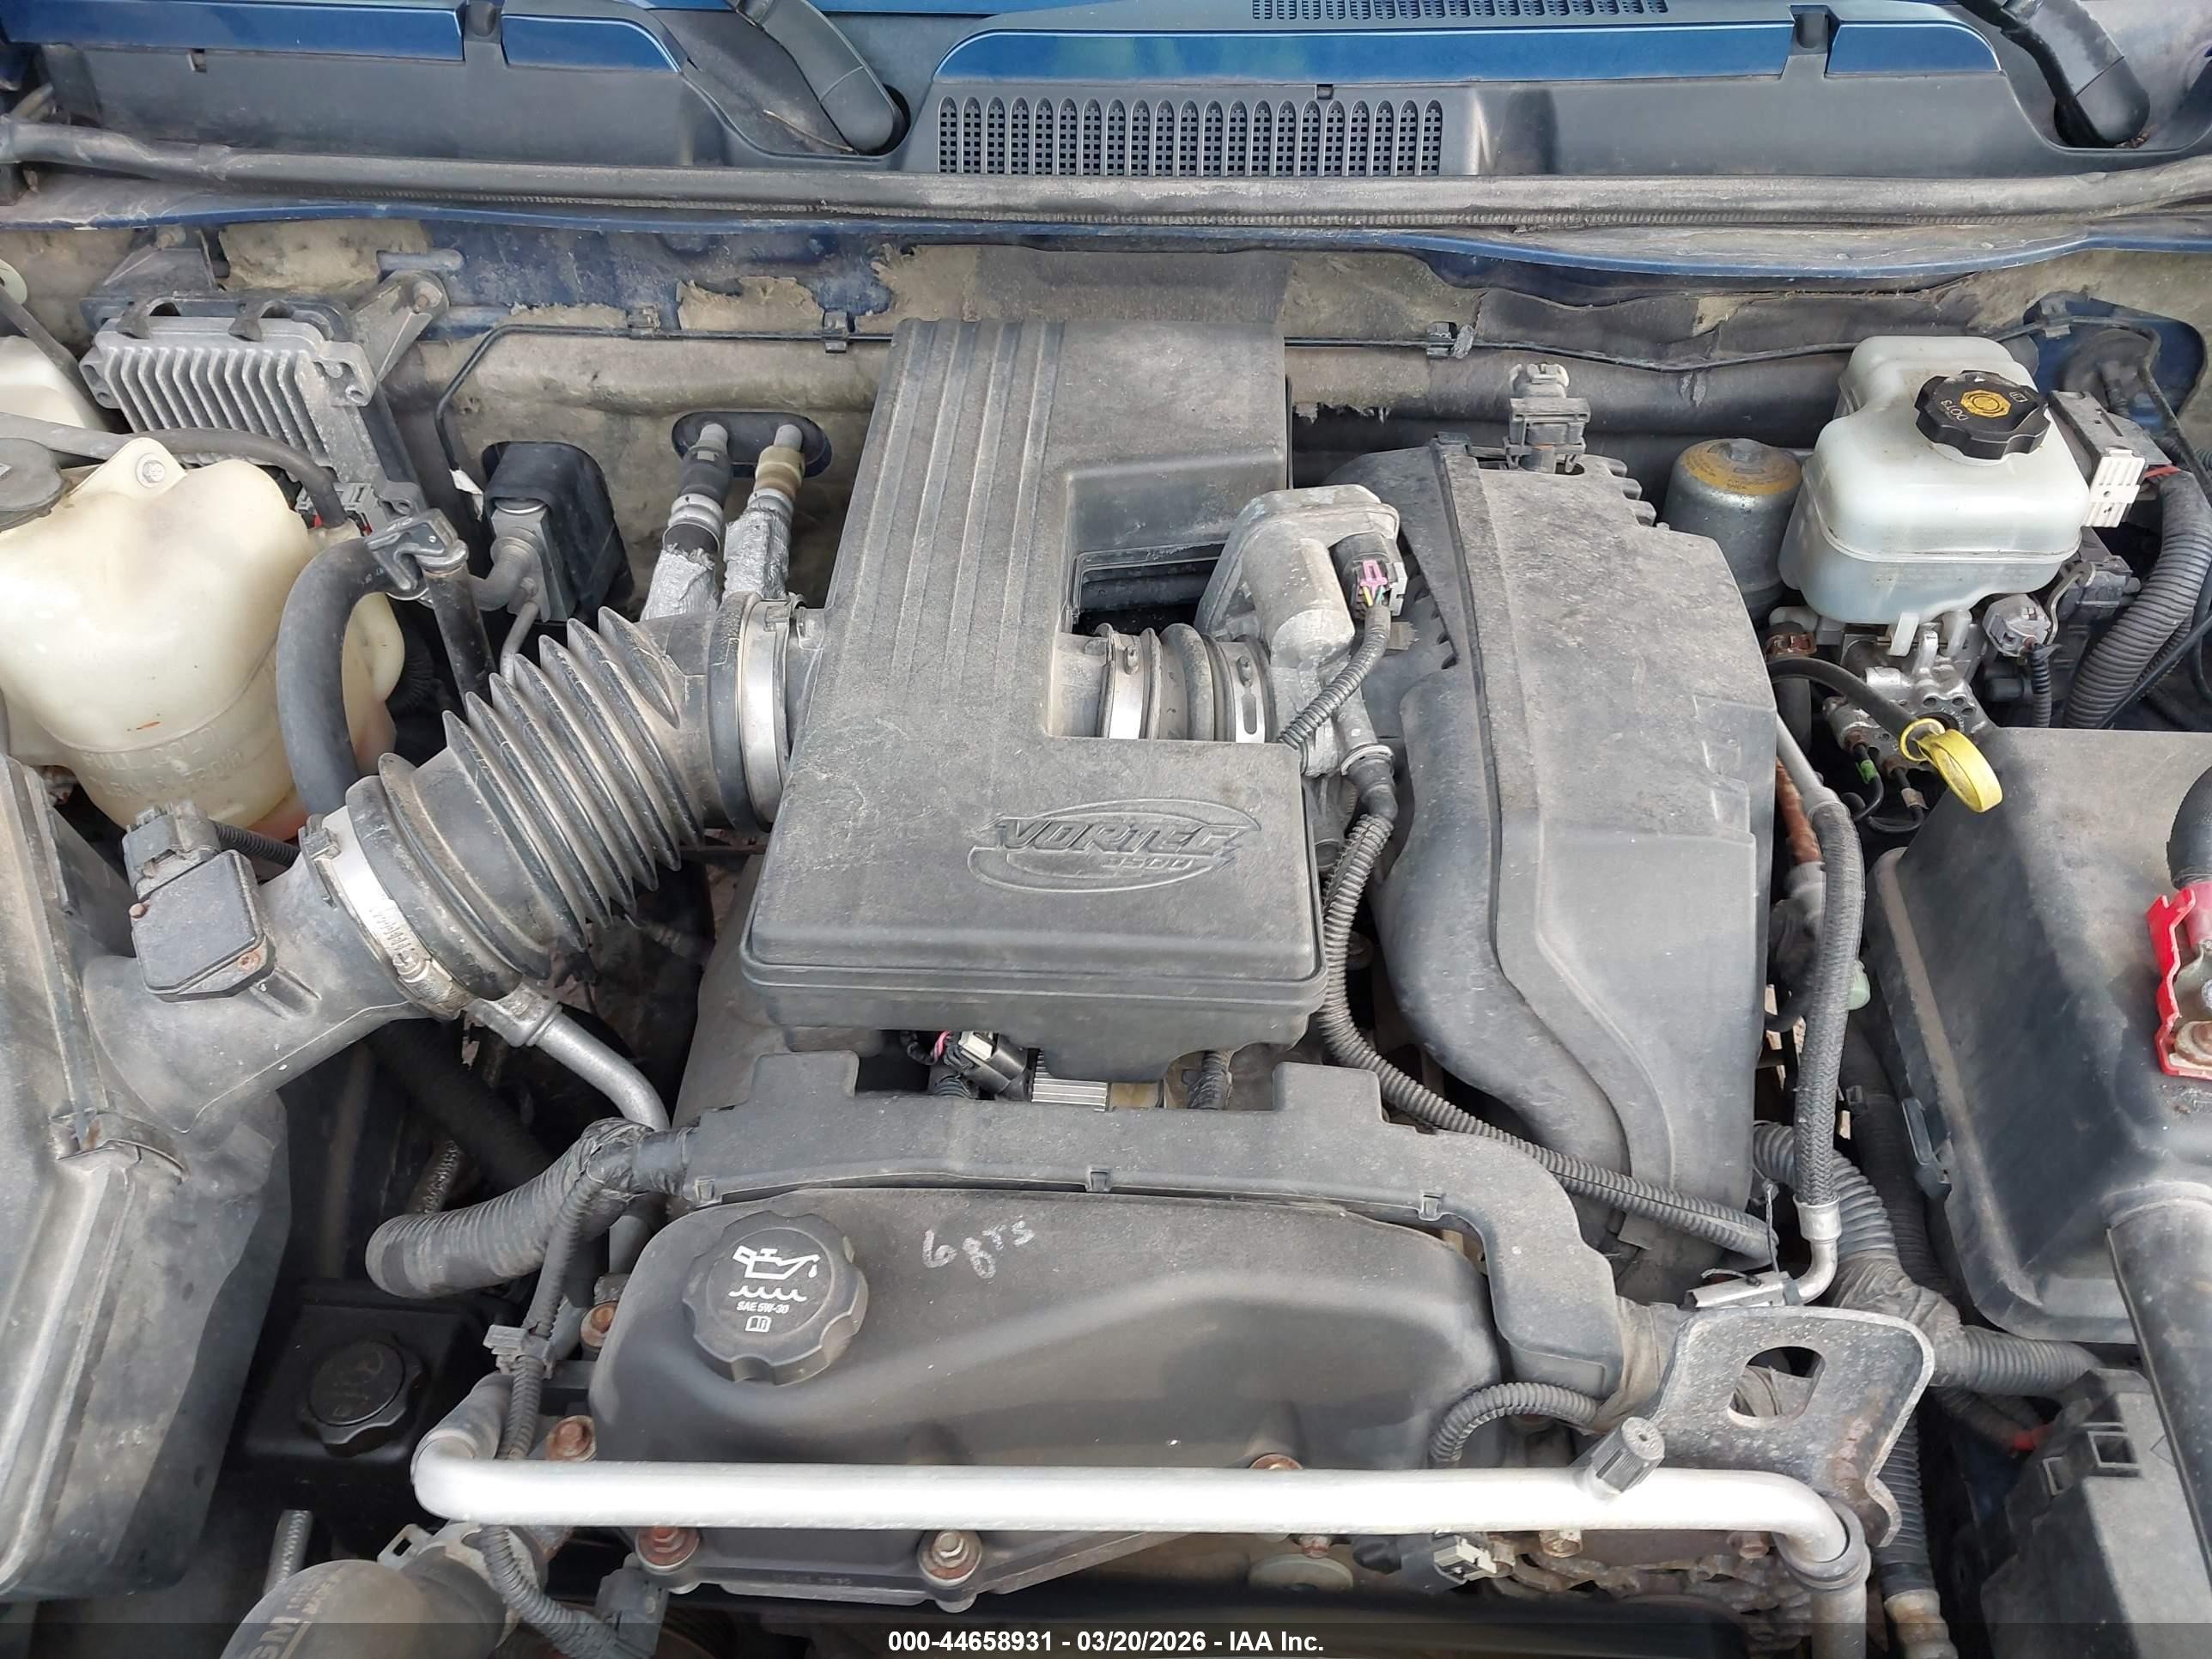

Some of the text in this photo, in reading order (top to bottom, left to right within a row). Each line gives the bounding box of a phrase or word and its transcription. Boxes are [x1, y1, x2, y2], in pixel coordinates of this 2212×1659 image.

[1940, 398, 1970, 422] DOT3
[994, 818, 1242, 860] VORTEC
[736, 1300, 791, 1315] SAE 5W-30
